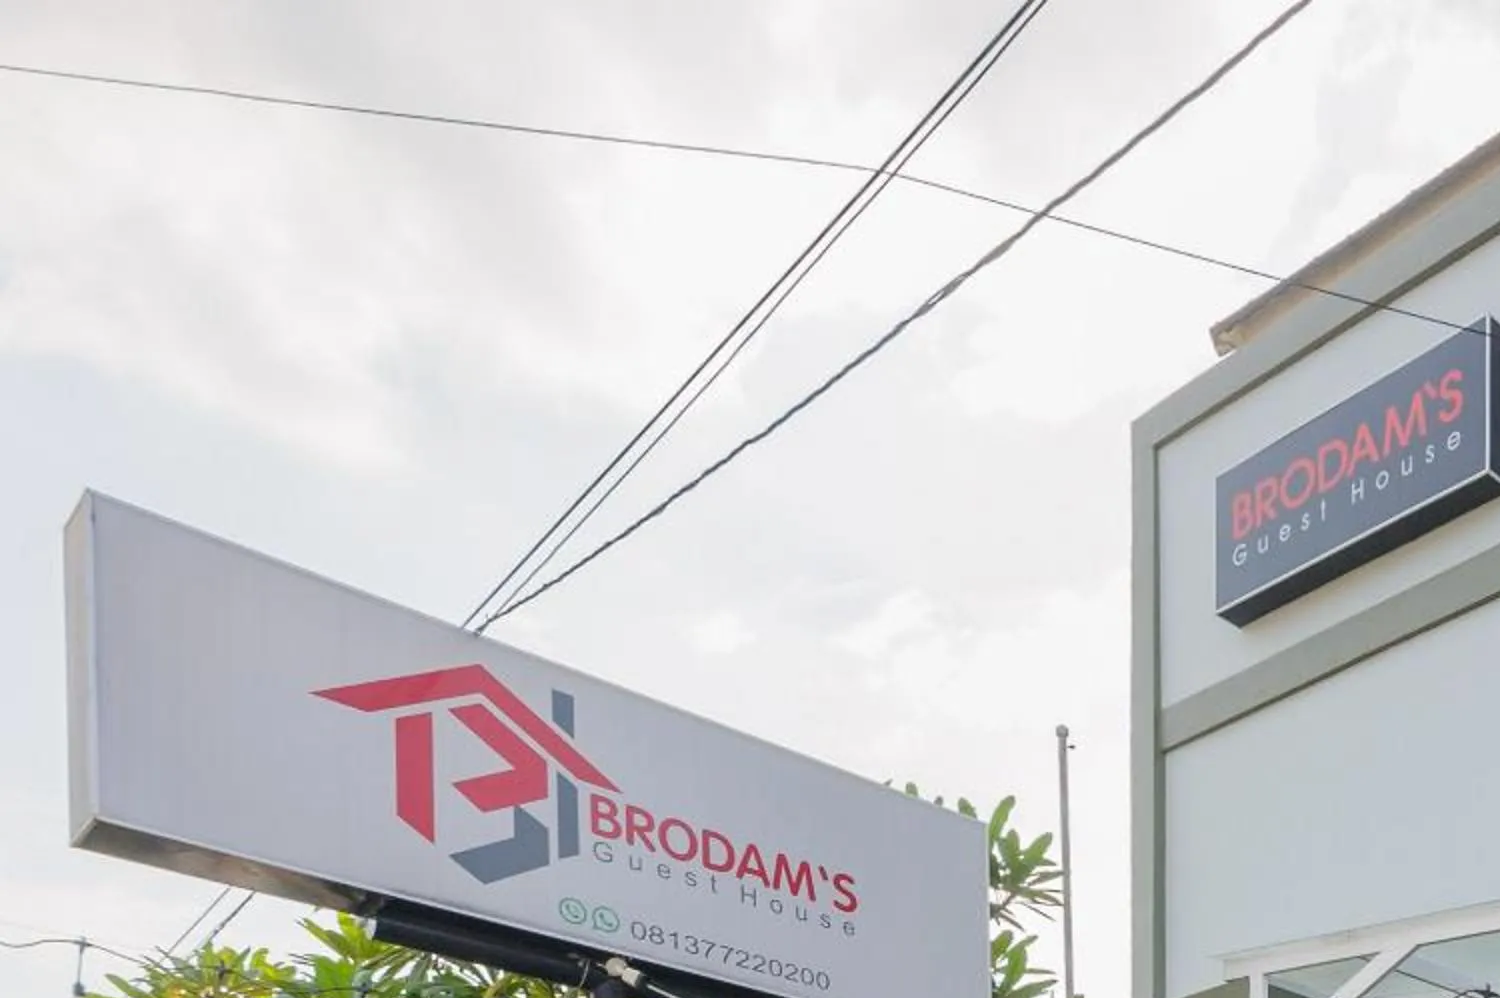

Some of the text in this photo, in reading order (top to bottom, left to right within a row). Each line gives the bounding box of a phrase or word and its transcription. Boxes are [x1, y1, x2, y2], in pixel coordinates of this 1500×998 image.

[1232, 431, 1462, 566] Guest House
[592, 841, 856, 937] Guest House
[630, 920, 831, 991] 081377220200
